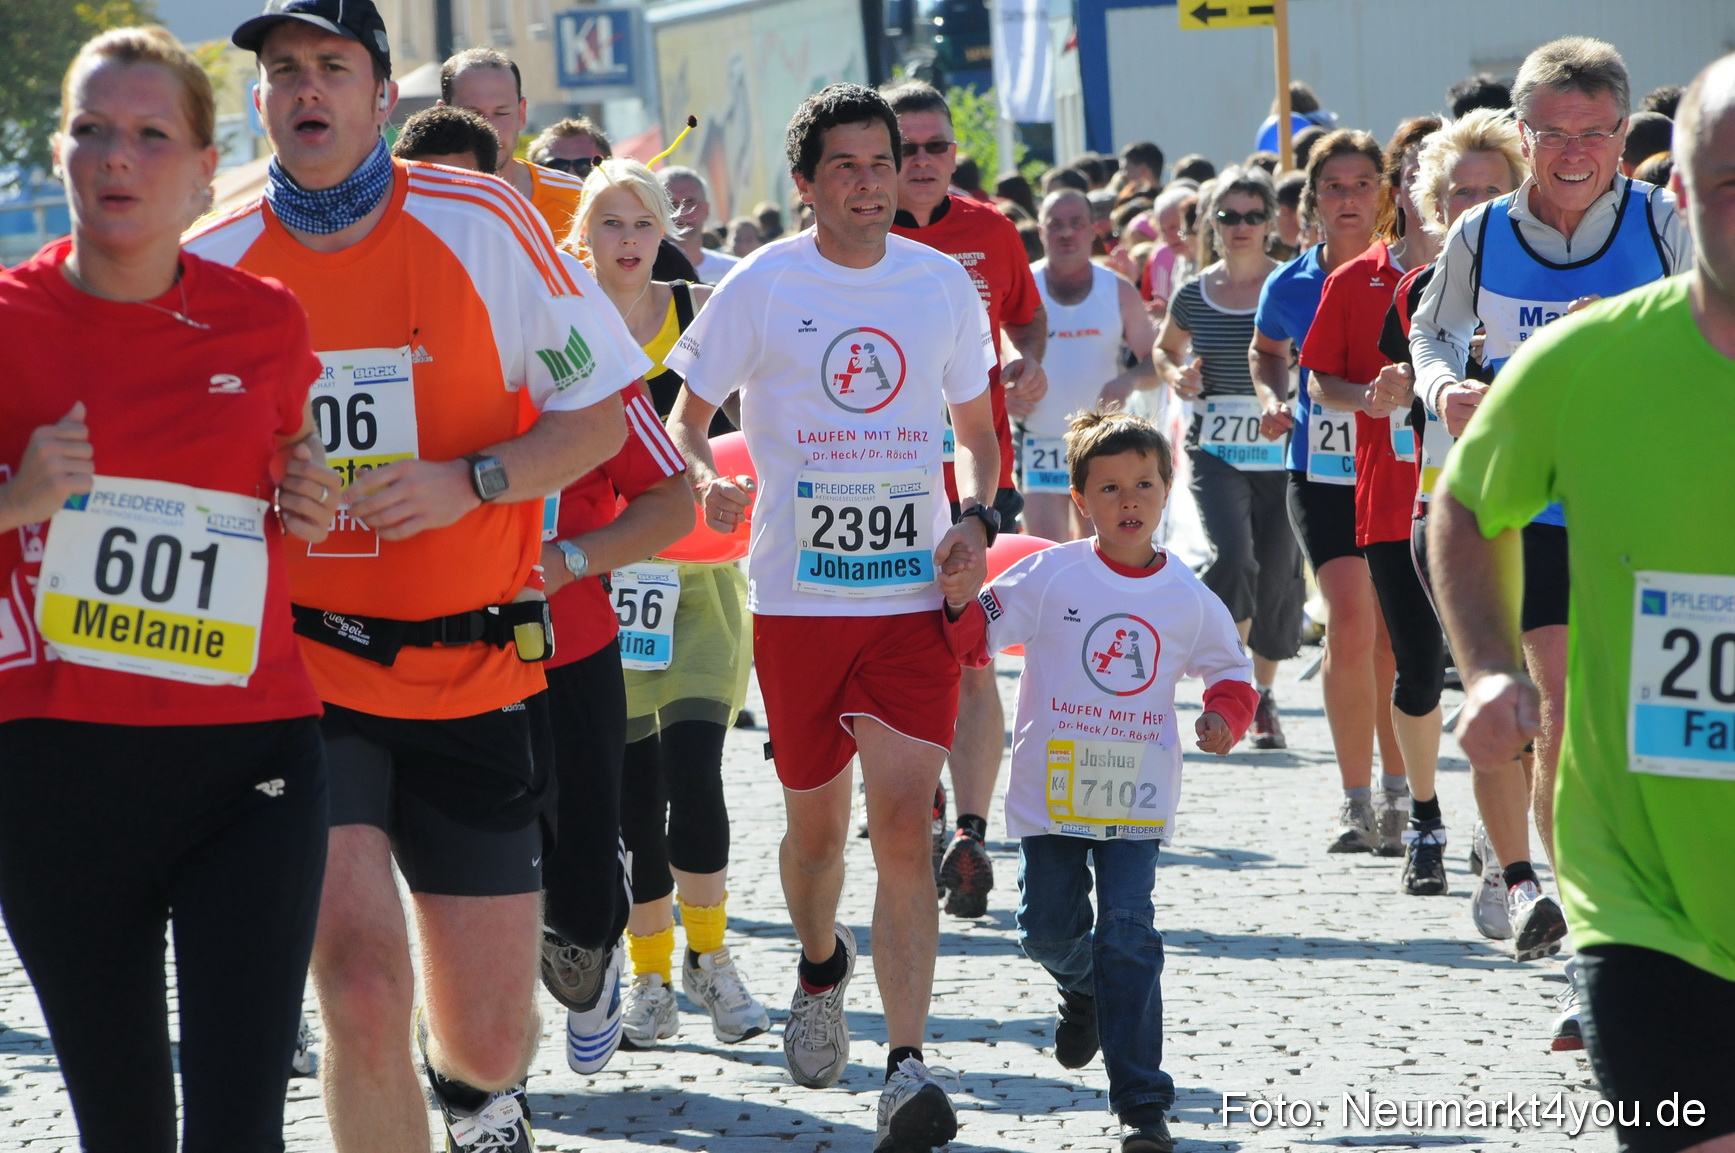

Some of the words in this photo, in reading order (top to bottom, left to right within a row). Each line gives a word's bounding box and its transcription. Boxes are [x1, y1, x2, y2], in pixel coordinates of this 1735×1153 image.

[353, 365, 397, 379] BOCK
[797, 429, 857, 444] LAUFEN
[864, 429, 892, 441] MIT
[897, 426, 929, 442] HERZ
[1319, 420, 1351, 452] 21
[812, 451, 828, 461] Dr.
[830, 449, 858, 460] Heck
[868, 449, 883, 460] Dr.
[886, 450, 918, 460] Röschl
[1217, 445, 1269, 463] Brigitte
[815, 483, 876, 495] PFLEIDERER
[91, 490, 186, 518] PFLEIDERER
[811, 503, 918, 552] 2394
[95, 526, 220, 610] 601
[810, 553, 922, 580] Johannes
[616, 588, 664, 630] 56
[72, 599, 225, 659] Melanie
[1051, 697, 1103, 718] LAUFEN
[1109, 709, 1136, 722] MIT
[1058, 720, 1073, 729] Dr.
[1075, 721, 1101, 734] Heck
[1111, 727, 1126, 737] Dr.
[1080, 748, 1136, 769] Joshua
[1051, 777, 1066, 791] K4
[1080, 779, 1158, 809] 7102
[1118, 824, 1164, 834] PFLEIDERER
